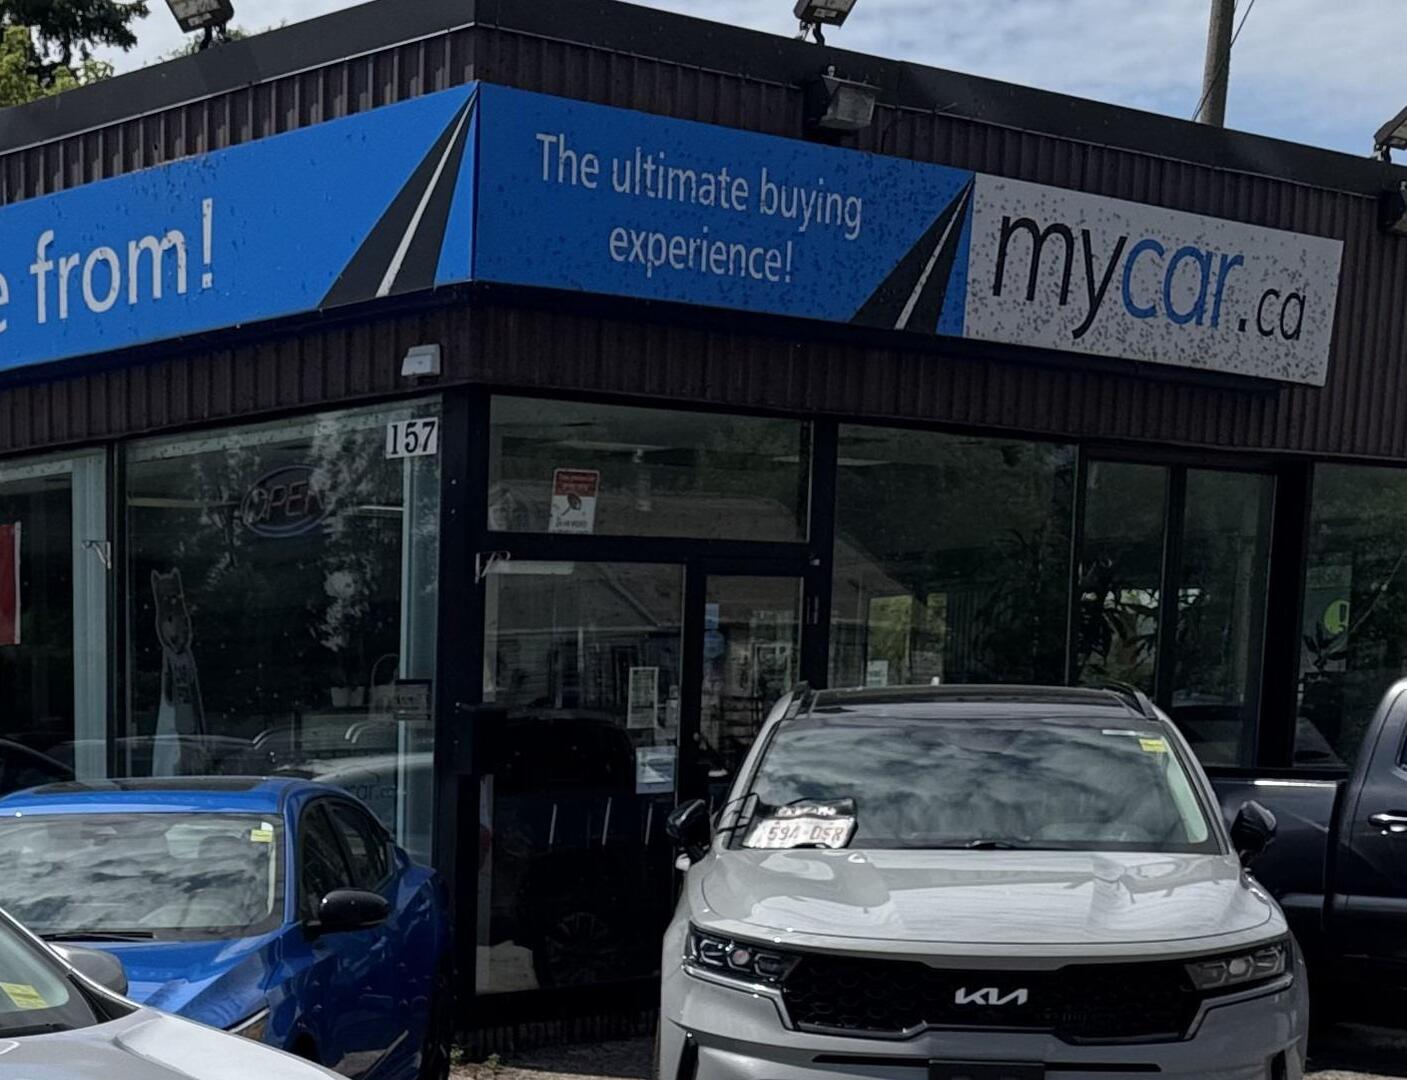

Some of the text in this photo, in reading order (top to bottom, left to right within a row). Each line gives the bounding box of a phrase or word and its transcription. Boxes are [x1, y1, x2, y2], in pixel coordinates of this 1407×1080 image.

[535, 133, 863, 241] The ultimate buying
[29, 198, 214, 325] from!
[609, 226, 792, 283] experience!
[992, 215, 1307, 342] mycar.ca
[390, 420, 436, 455] 157
[954, 986, 1029, 1006] KIA
